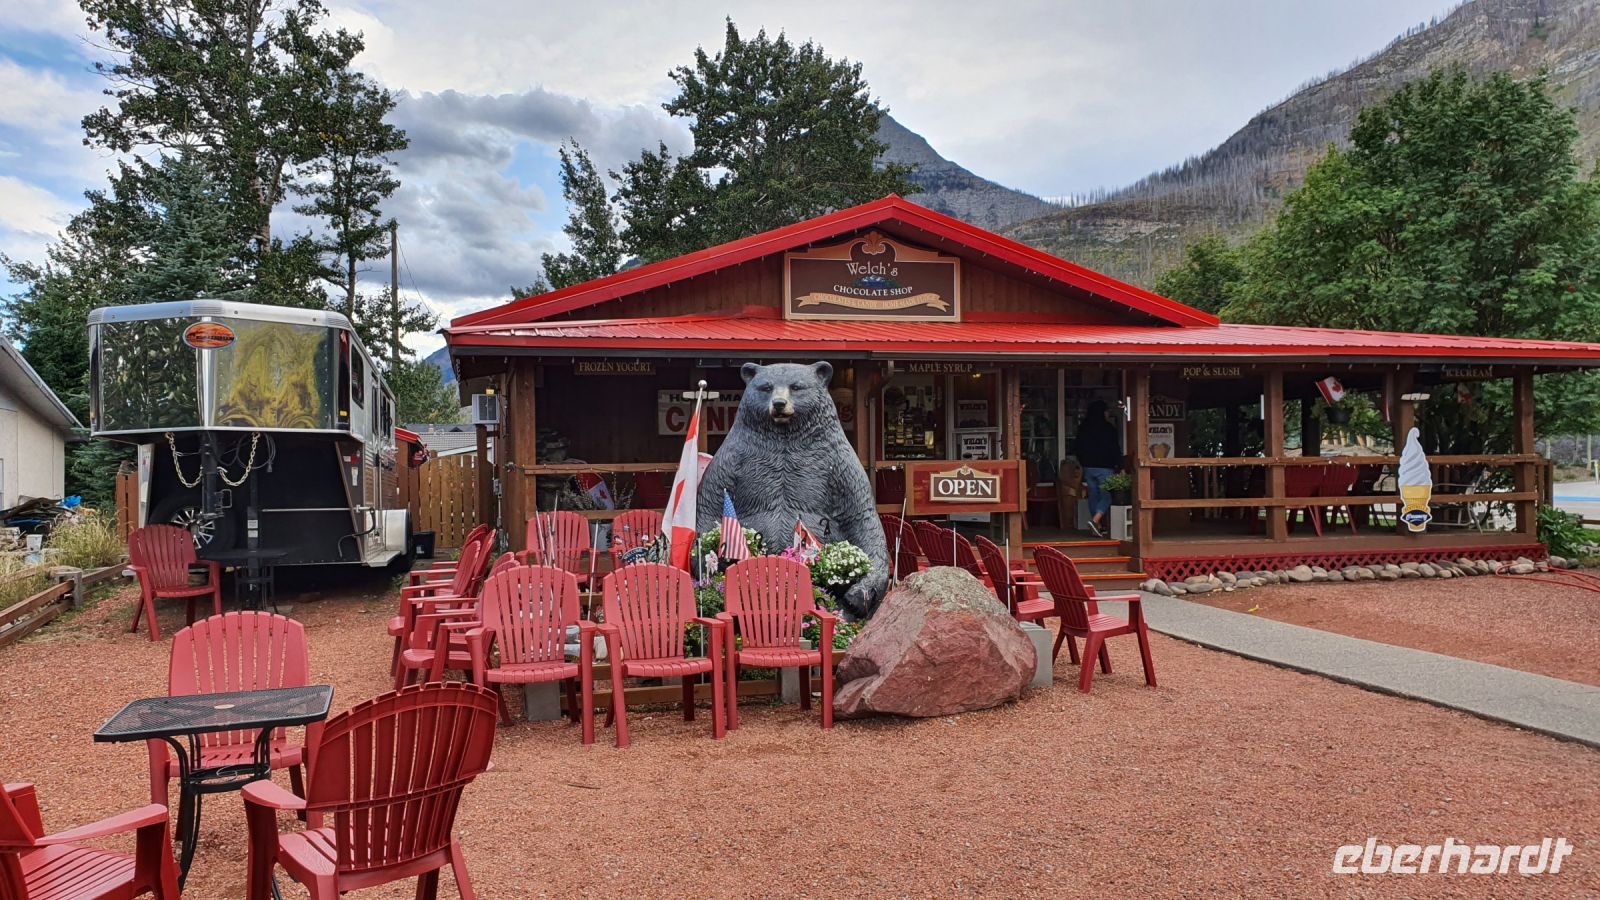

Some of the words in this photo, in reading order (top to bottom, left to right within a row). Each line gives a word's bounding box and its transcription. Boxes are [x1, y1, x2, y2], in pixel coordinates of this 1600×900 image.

[846, 262, 898, 276] Welch's
[833, 284, 888, 296] CHOCOLATE
[890, 286, 913, 296] SHOP
[578, 361, 614, 372] FROZEN
[616, 361, 651, 372] YOGURT
[910, 362, 941, 373] MAPLE
[943, 363, 973, 373] SYRUP
[1183, 367, 1202, 376] POP
[1203, 367, 1211, 376] &
[1213, 367, 1240, 376] SLUSH
[1150, 404, 1180, 417] ANDY
[938, 478, 993, 496] OPEN
